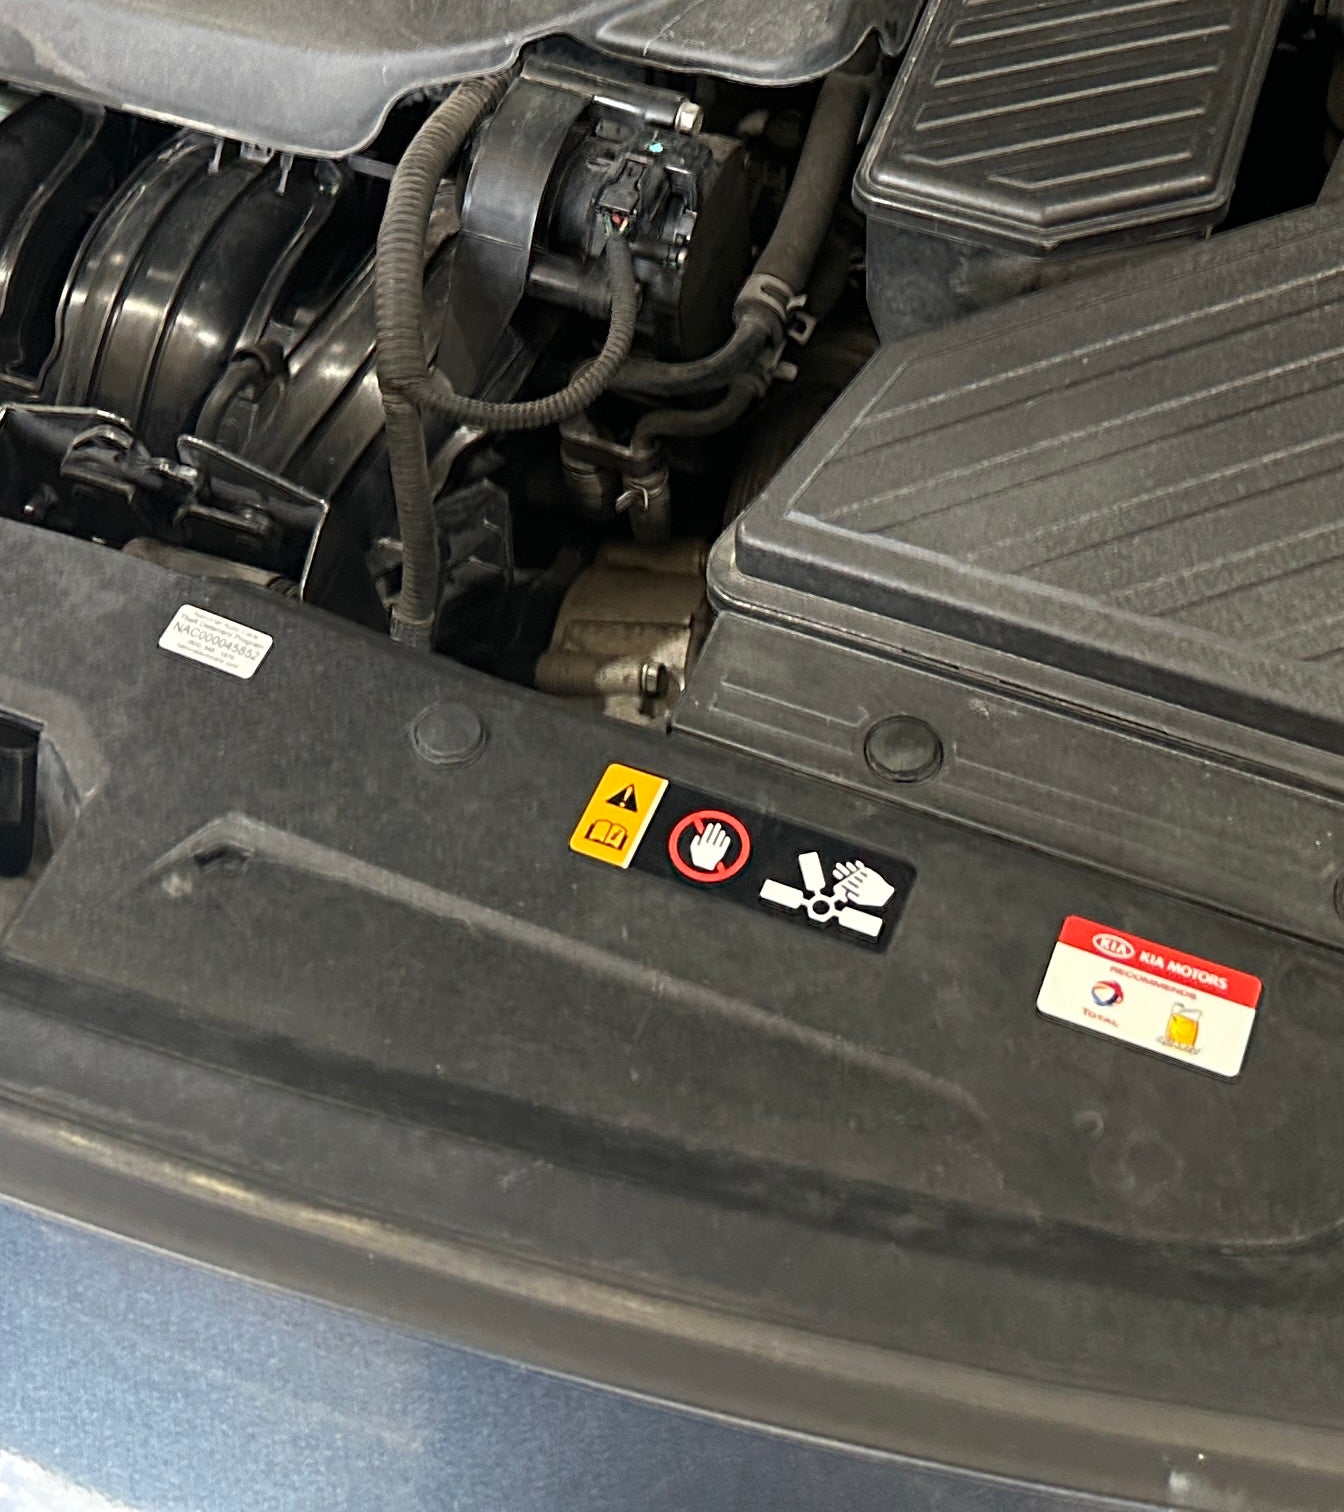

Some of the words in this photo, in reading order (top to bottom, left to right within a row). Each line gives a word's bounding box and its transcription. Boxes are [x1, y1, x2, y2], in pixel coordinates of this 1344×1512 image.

[1099, 937, 1127, 955] KIA
[1139, 950, 1164, 968] KIA
[1166, 960, 1227, 990] MOTORS
